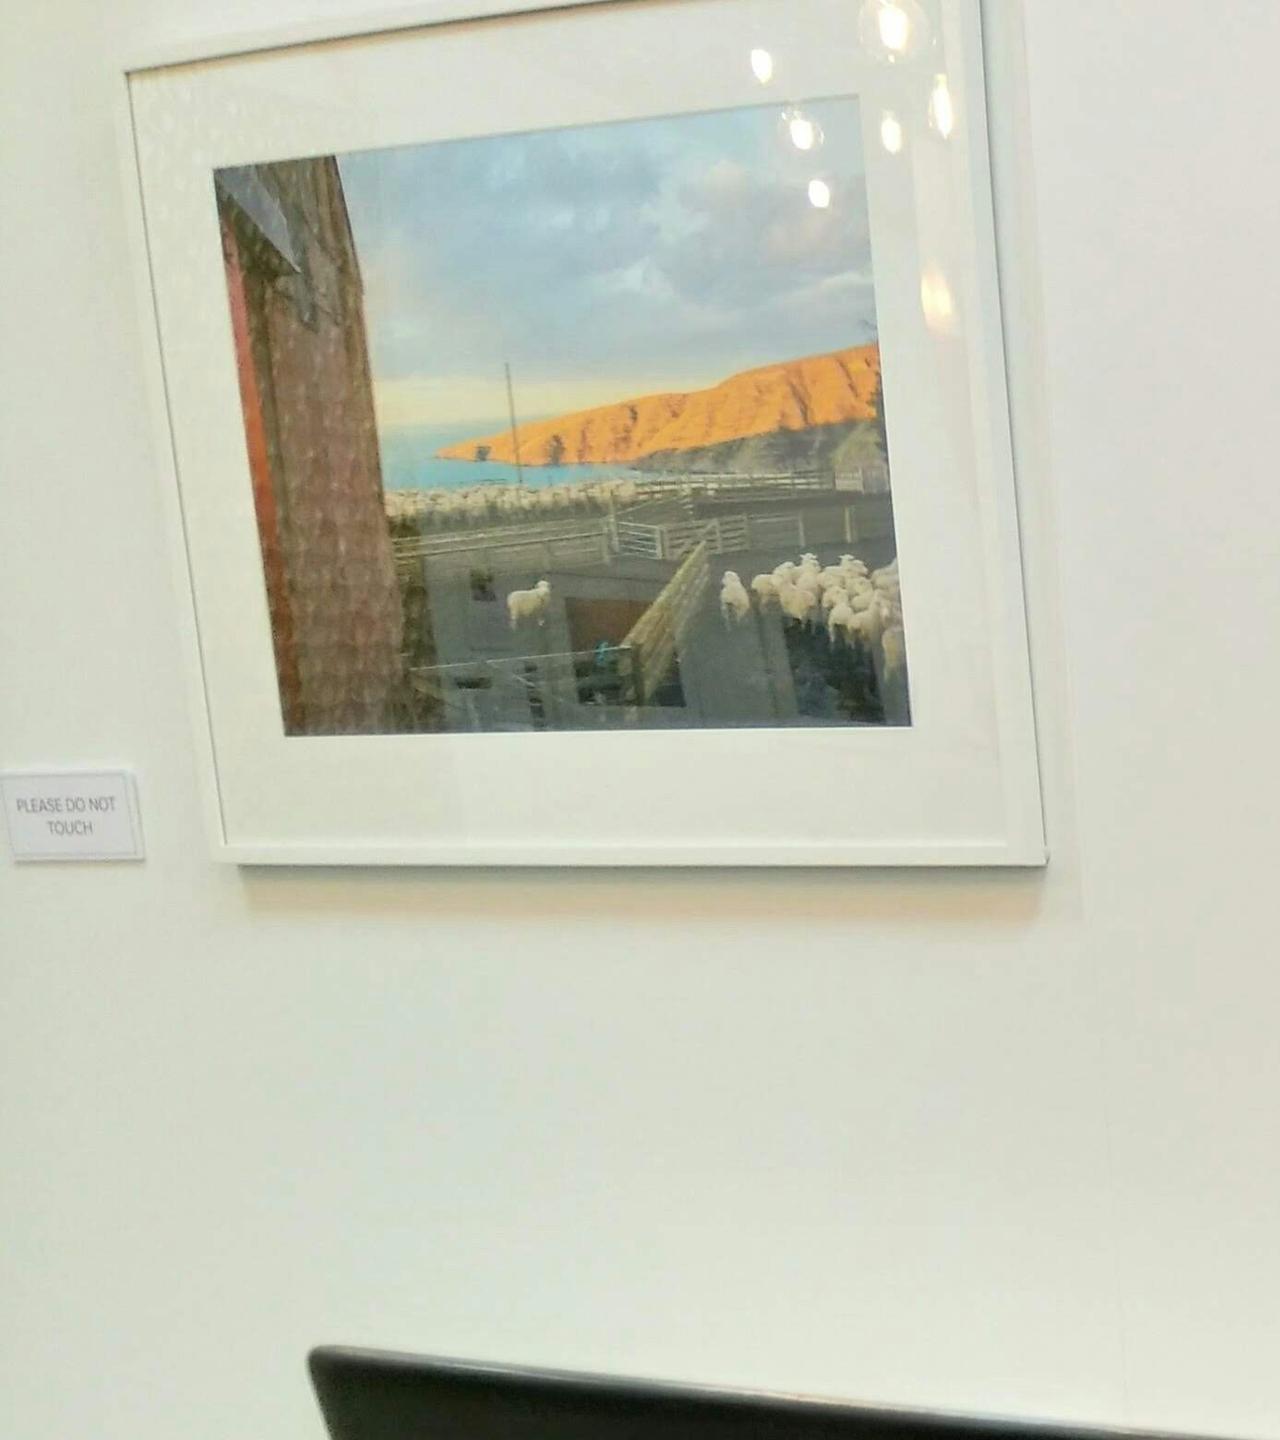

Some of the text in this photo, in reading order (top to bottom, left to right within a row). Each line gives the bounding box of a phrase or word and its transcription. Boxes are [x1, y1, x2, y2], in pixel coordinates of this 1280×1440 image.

[16, 796, 115, 813] PLEASE DO NOT
[47, 819, 93, 836] TOUCH
